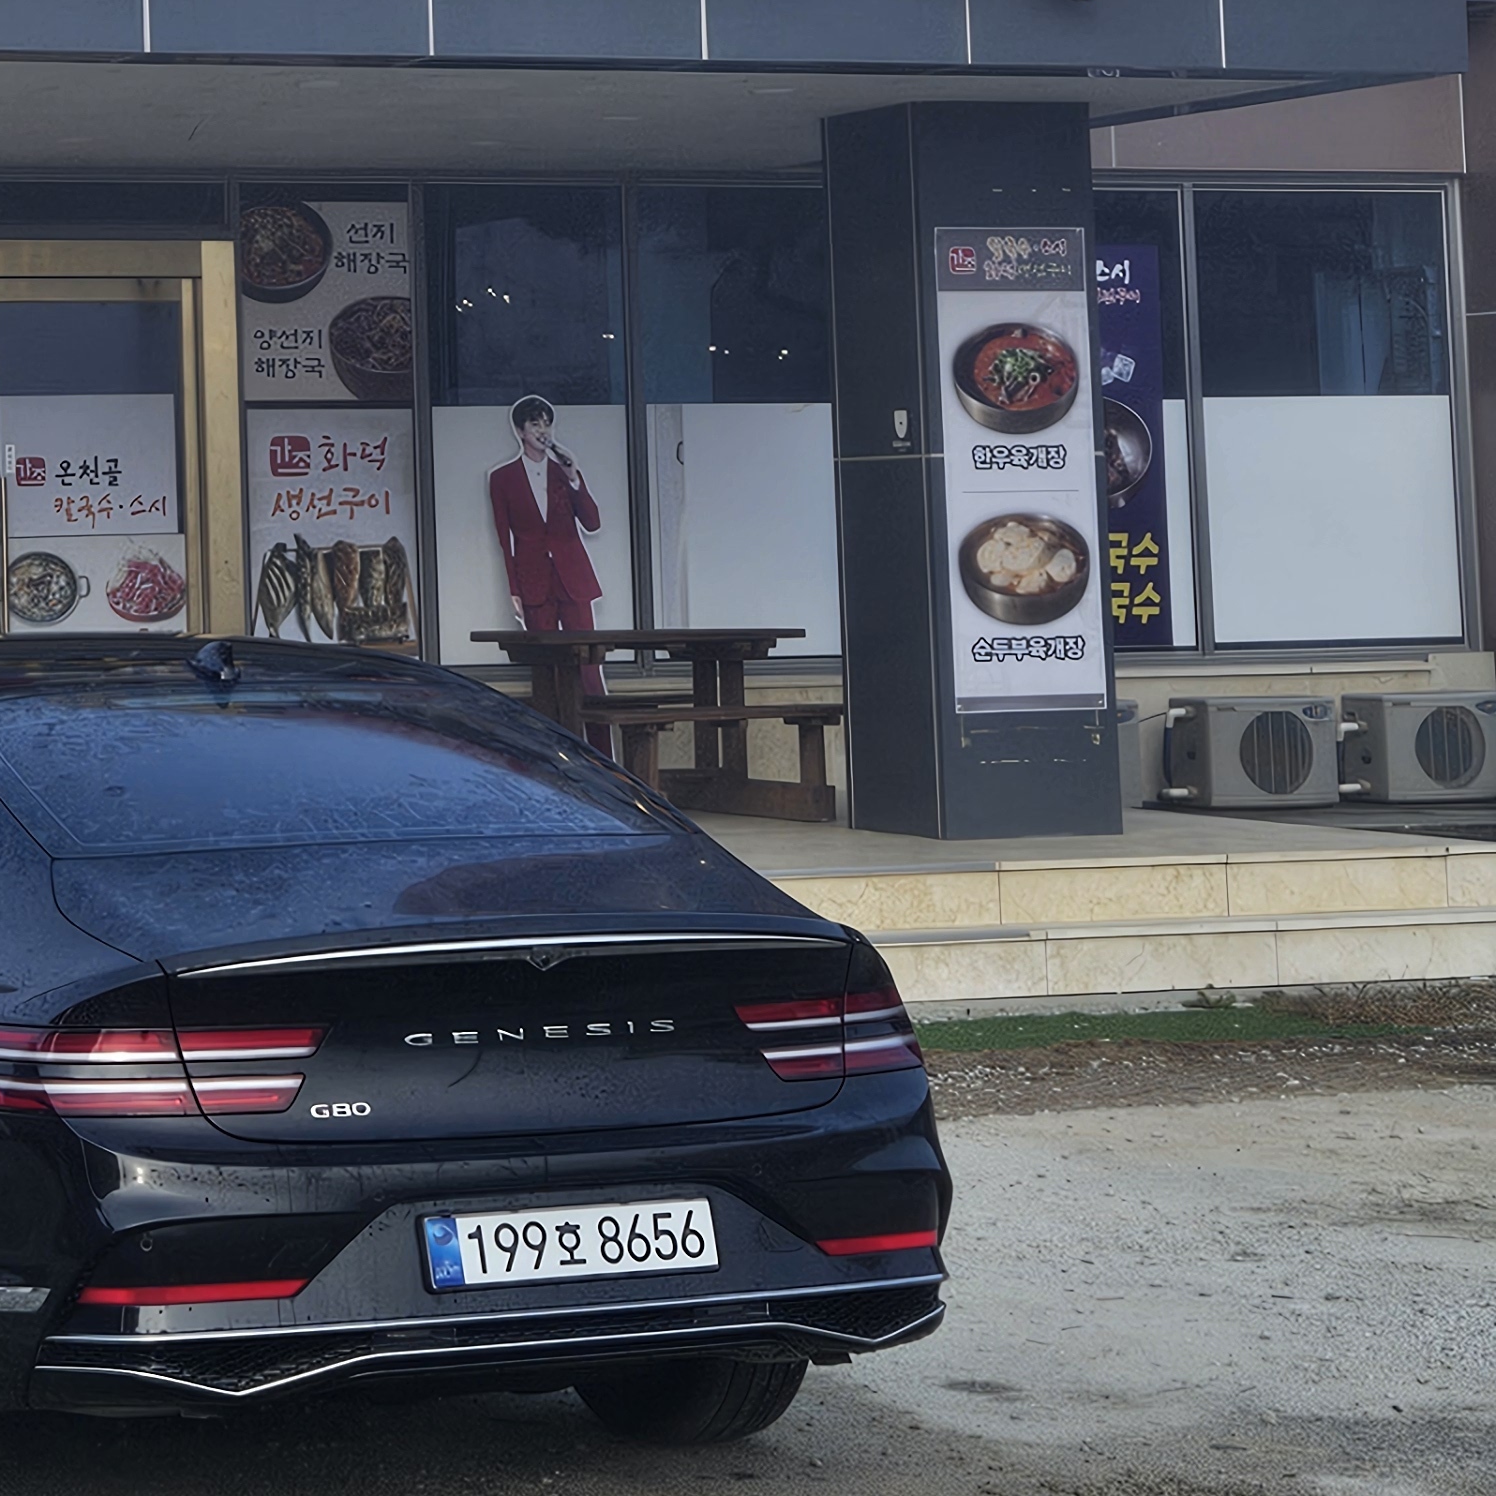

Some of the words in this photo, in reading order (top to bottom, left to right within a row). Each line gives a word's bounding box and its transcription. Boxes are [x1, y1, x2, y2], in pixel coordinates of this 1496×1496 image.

[346, 222, 395, 244] 선지
[333, 252, 410, 274] 해장국
[254, 357, 326, 379] 해장국
[317, 435, 388, 472] 화덕
[54, 455, 122, 487] 온천골
[271, 487, 391, 521] 생선구이
[404, 1019, 675, 1047] GENESIS
[309, 1101, 372, 1119] G80
